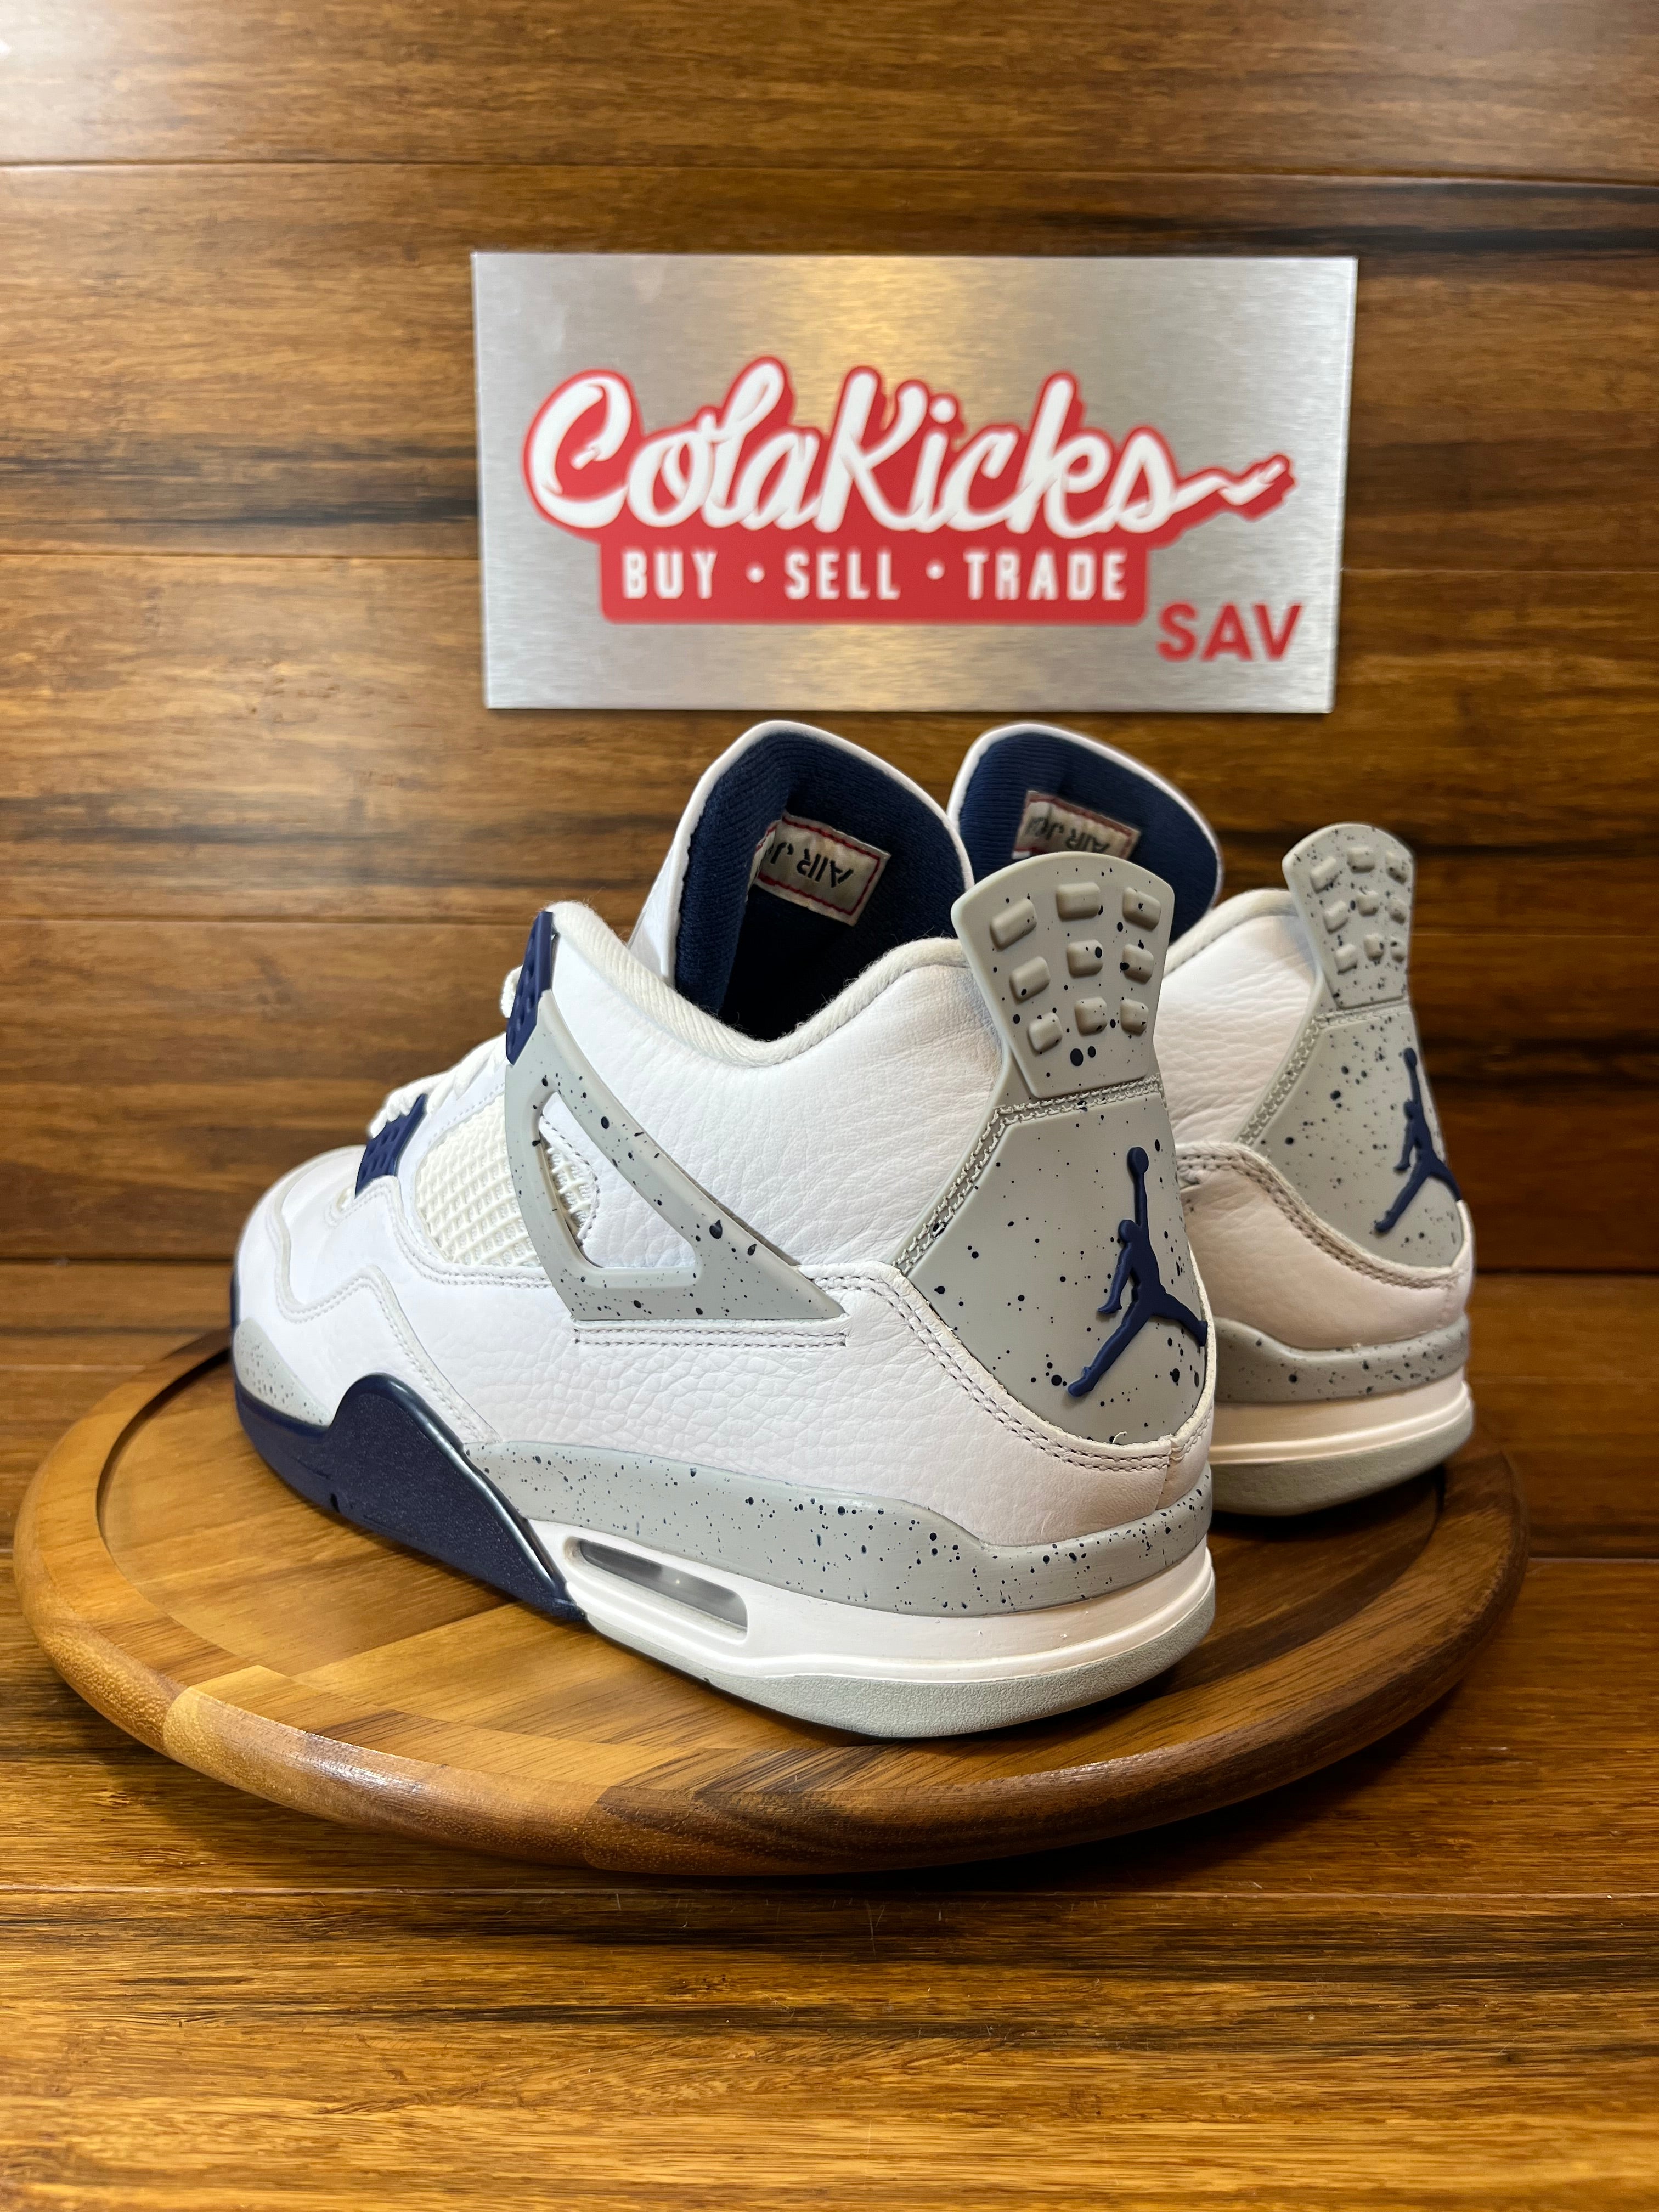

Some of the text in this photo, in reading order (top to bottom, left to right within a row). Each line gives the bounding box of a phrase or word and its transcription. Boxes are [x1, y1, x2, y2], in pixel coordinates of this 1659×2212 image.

[527, 357, 1286, 539] ColaKicks
[622, 550, 1127, 600] BUY SELL TRADE
[1154, 601, 1303, 662] SAV
[769, 842, 854, 888] AIR J
